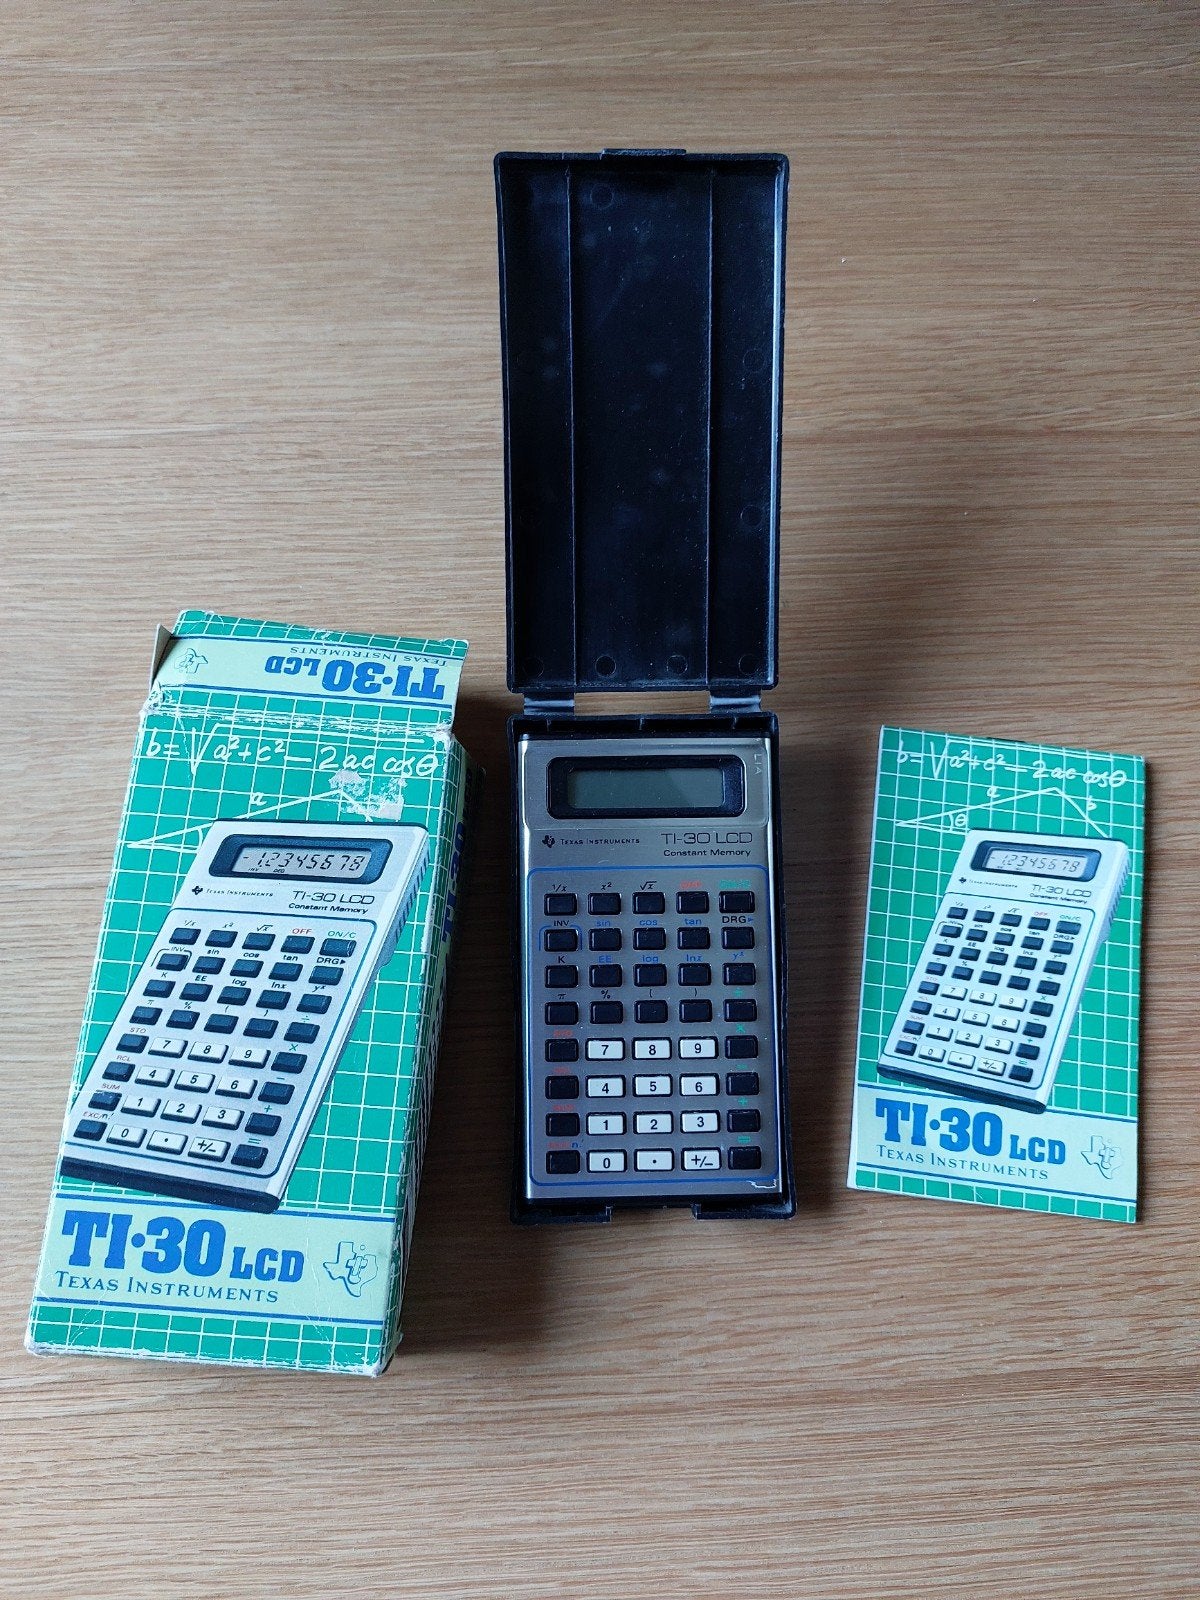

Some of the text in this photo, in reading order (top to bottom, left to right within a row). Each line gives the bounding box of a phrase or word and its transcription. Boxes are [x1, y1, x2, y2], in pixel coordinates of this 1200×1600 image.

[290, 646, 448, 666] TEXAS INSTRUMENTS
[264, 656, 319, 676] LCD
[661, 832, 753, 845] TI-30 LCD
[664, 849, 751, 857] Constant Memory
[1032, 884, 1092, 898] TI-30 LCD
[293, 890, 375, 904] TI-30 LCD
[289, 903, 369, 914] Constant Memory
[328, 930, 356, 938] ON/C
[558, 955, 566, 963] K
[232, 978, 247, 986] log
[601, 990, 610, 999] %
[184, 1002, 192, 1010] %
[163, 1040, 171, 1049] 7
[203, 1045, 211, 1054] 8
[694, 1043, 701, 1053] 9
[244, 1050, 252, 1058] 9
[601, 1045, 609, 1055] 7
[649, 1045, 656, 1055] 8
[149, 1070, 156, 1078] 4
[190, 1075, 199, 1084] 5
[231, 1080, 239, 1089] 6
[602, 1083, 609, 1094] 4
[650, 1081, 657, 1092] 5
[695, 1082, 703, 1093] 6
[137, 1097, 143, 1106] 1
[177, 1103, 185, 1113] 2
[218, 1110, 226, 1119] 3
[603, 1120, 609, 1130] 1
[650, 1119, 657, 1130] 2
[697, 1116, 704, 1127] 3
[121, 1129, 129, 1138] 0
[1010, 1134, 1066, 1165] LCD
[603, 1158, 610, 1168] 0
[875, 1144, 1048, 1179] TEXAS INSTRUMENTS
[230, 1246, 305, 1283] LCD
[55, 1270, 279, 1303] TEXAS INSTRUMENTS
